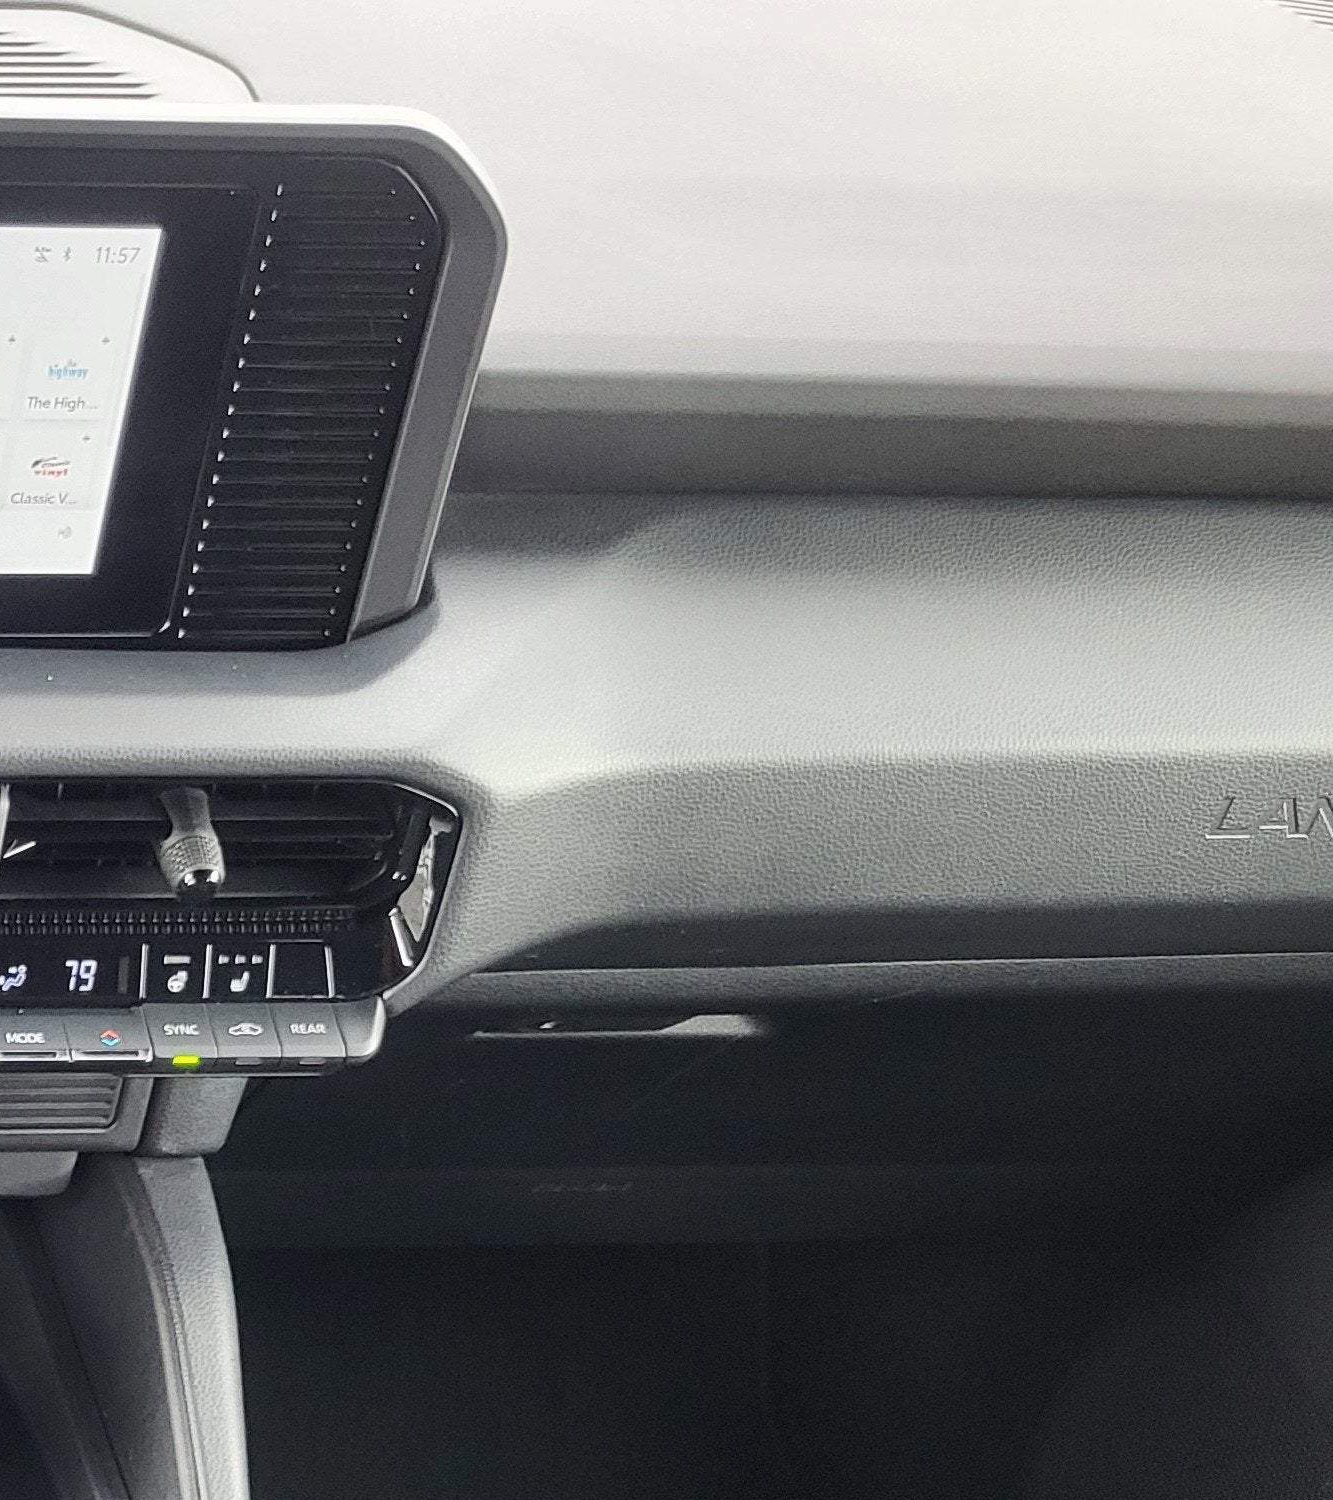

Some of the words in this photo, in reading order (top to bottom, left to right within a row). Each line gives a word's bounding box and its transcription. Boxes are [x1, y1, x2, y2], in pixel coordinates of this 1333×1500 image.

[95, 247, 140, 264] 11:57
[47, 364, 89, 380] highway
[27, 396, 52, 409] The
[10, 492, 54, 505] Classic
[65, 959, 98, 992] 79
[163, 1024, 200, 1037] SYNC
[290, 1023, 326, 1035] REAR
[5, 1032, 46, 1045] MODE
